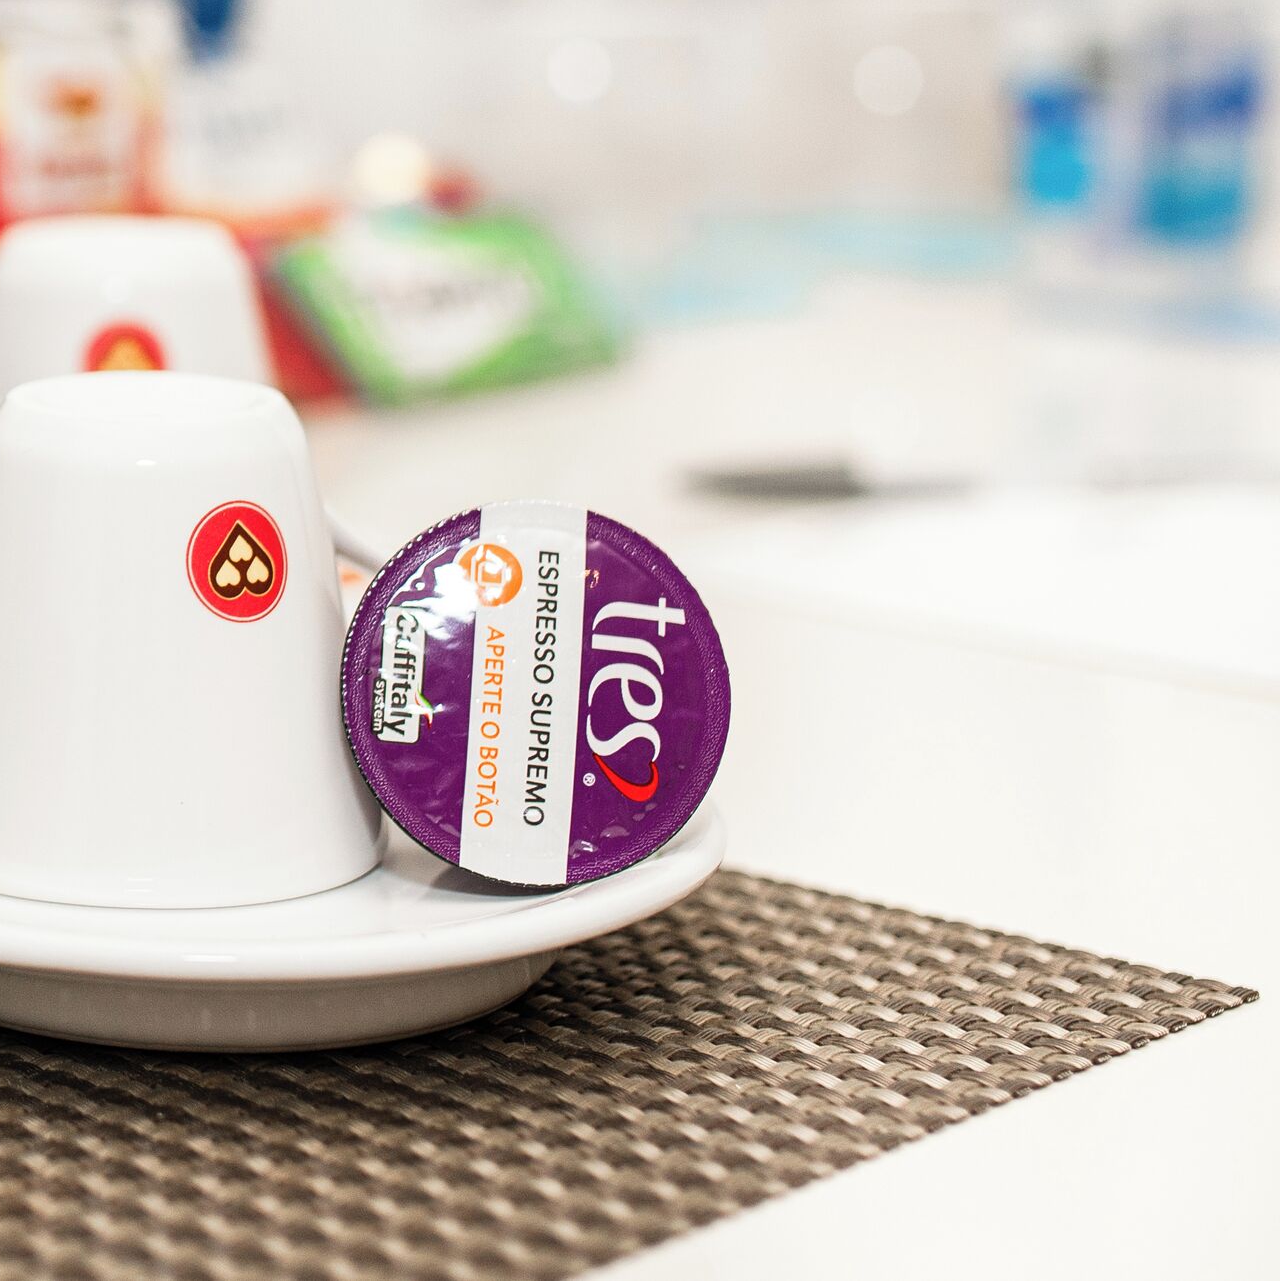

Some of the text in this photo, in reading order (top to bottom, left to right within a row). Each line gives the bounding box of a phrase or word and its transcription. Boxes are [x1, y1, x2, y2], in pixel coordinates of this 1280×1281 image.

[372, 680, 386, 732] system
[473, 625, 505, 828] APERTE O BOTÃO
[523, 550, 559, 826] ESPRESSO SUPREMO
[586, 597, 686, 762] tres
